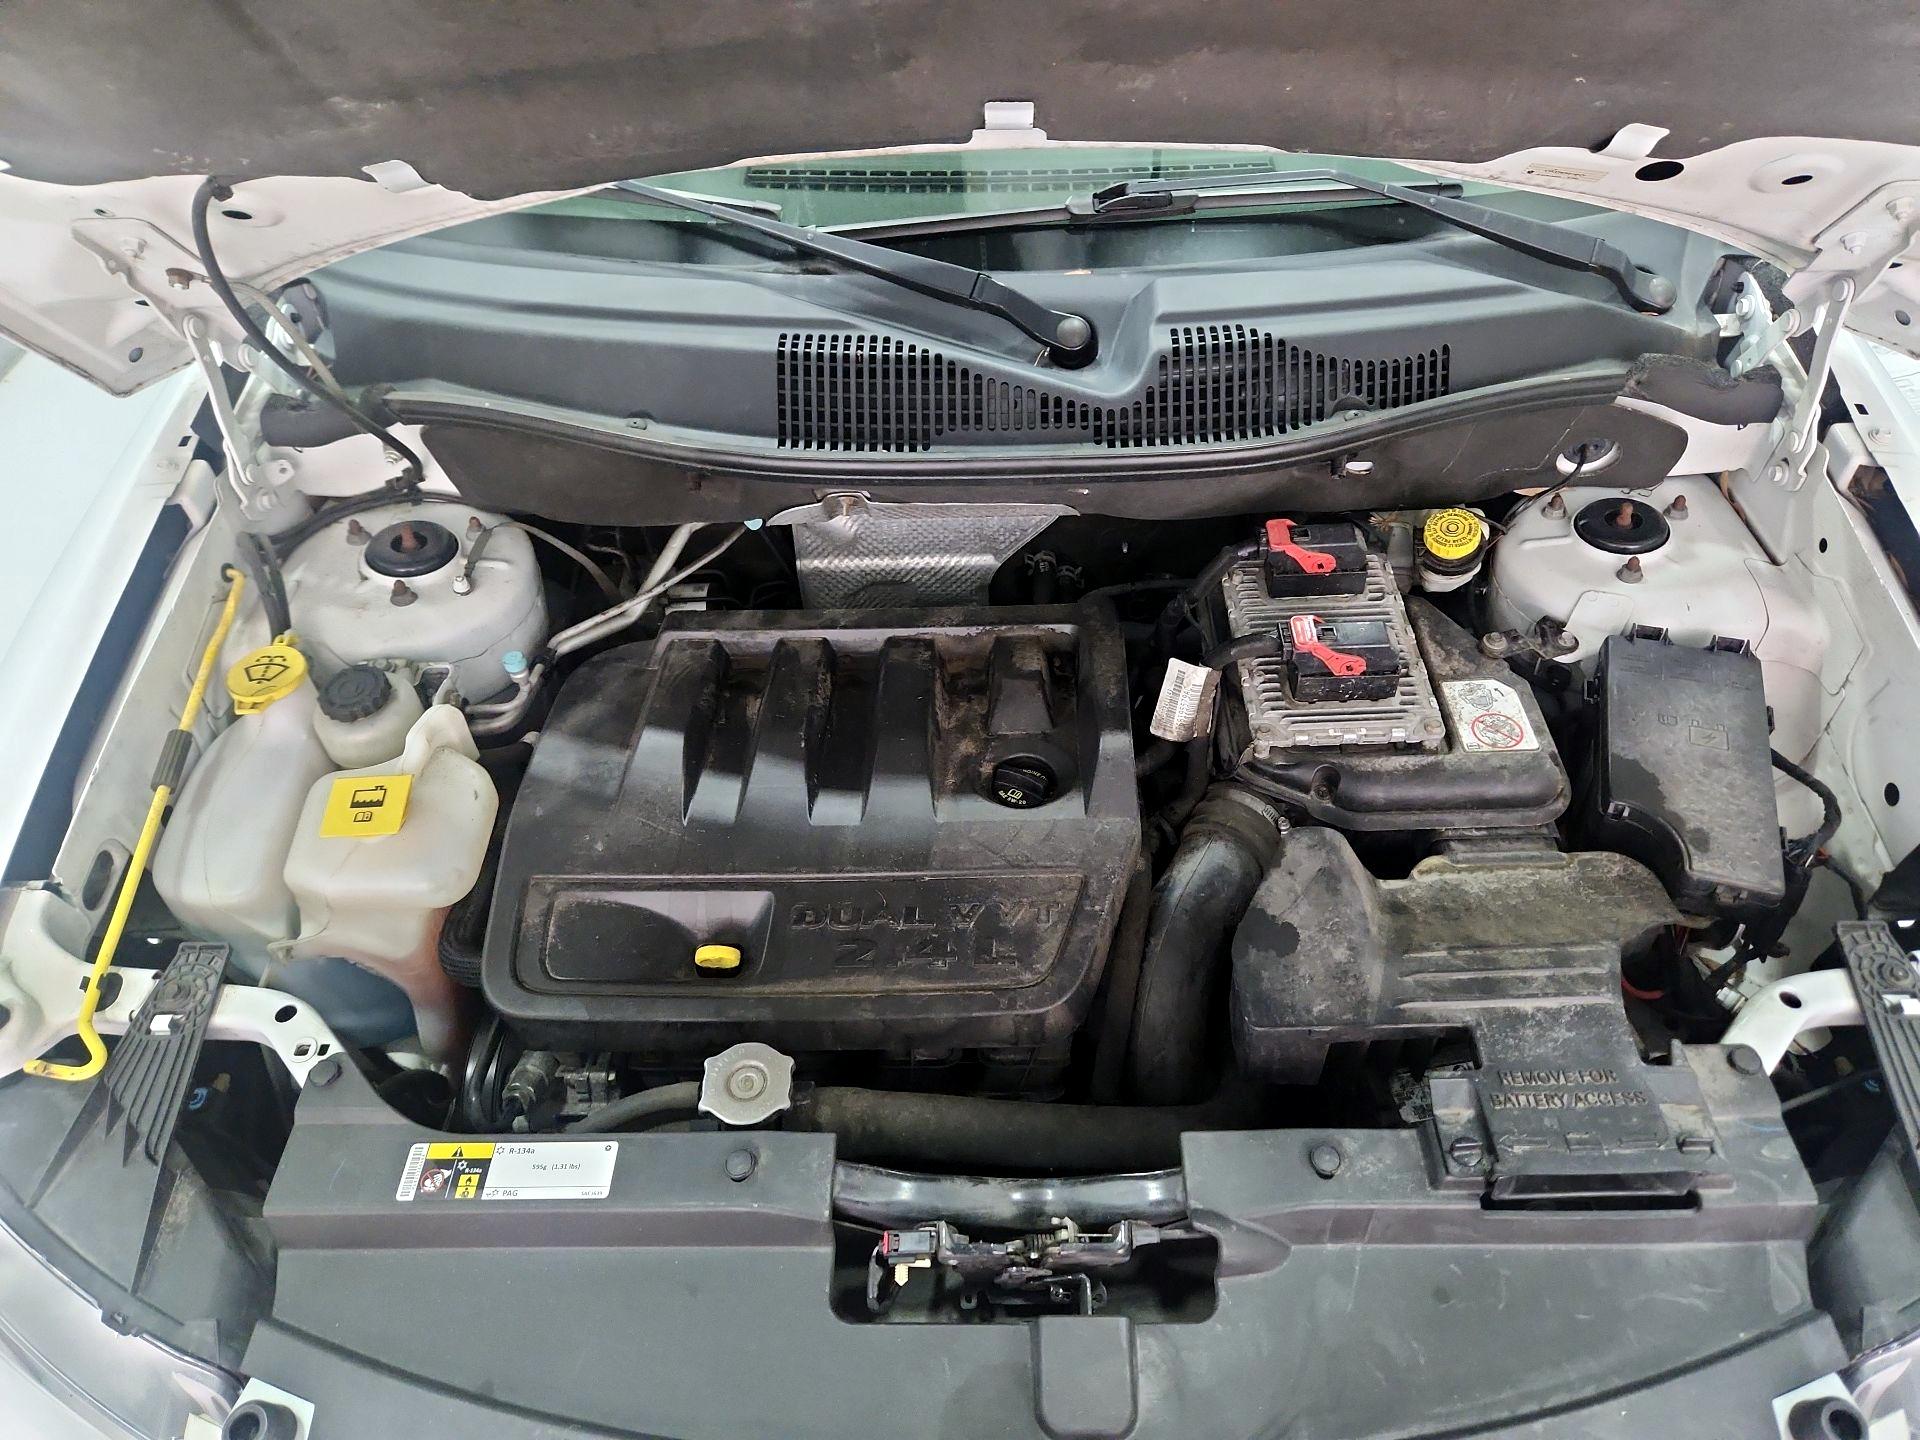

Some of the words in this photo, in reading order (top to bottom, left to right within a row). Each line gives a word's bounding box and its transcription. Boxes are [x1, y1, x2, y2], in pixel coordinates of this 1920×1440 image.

[791, 902, 936, 931] DUAL
[1498, 1070, 1575, 1086] REMOVE
[1578, 1069, 1618, 1084] FOR
[1490, 1092, 1567, 1109] BATTERY
[1573, 1091, 1648, 1108] ACCESS
[509, 1147, 535, 1155] R-134a
[551, 1163, 568, 1171] (1.31
[503, 1189, 518, 1197] PAG
